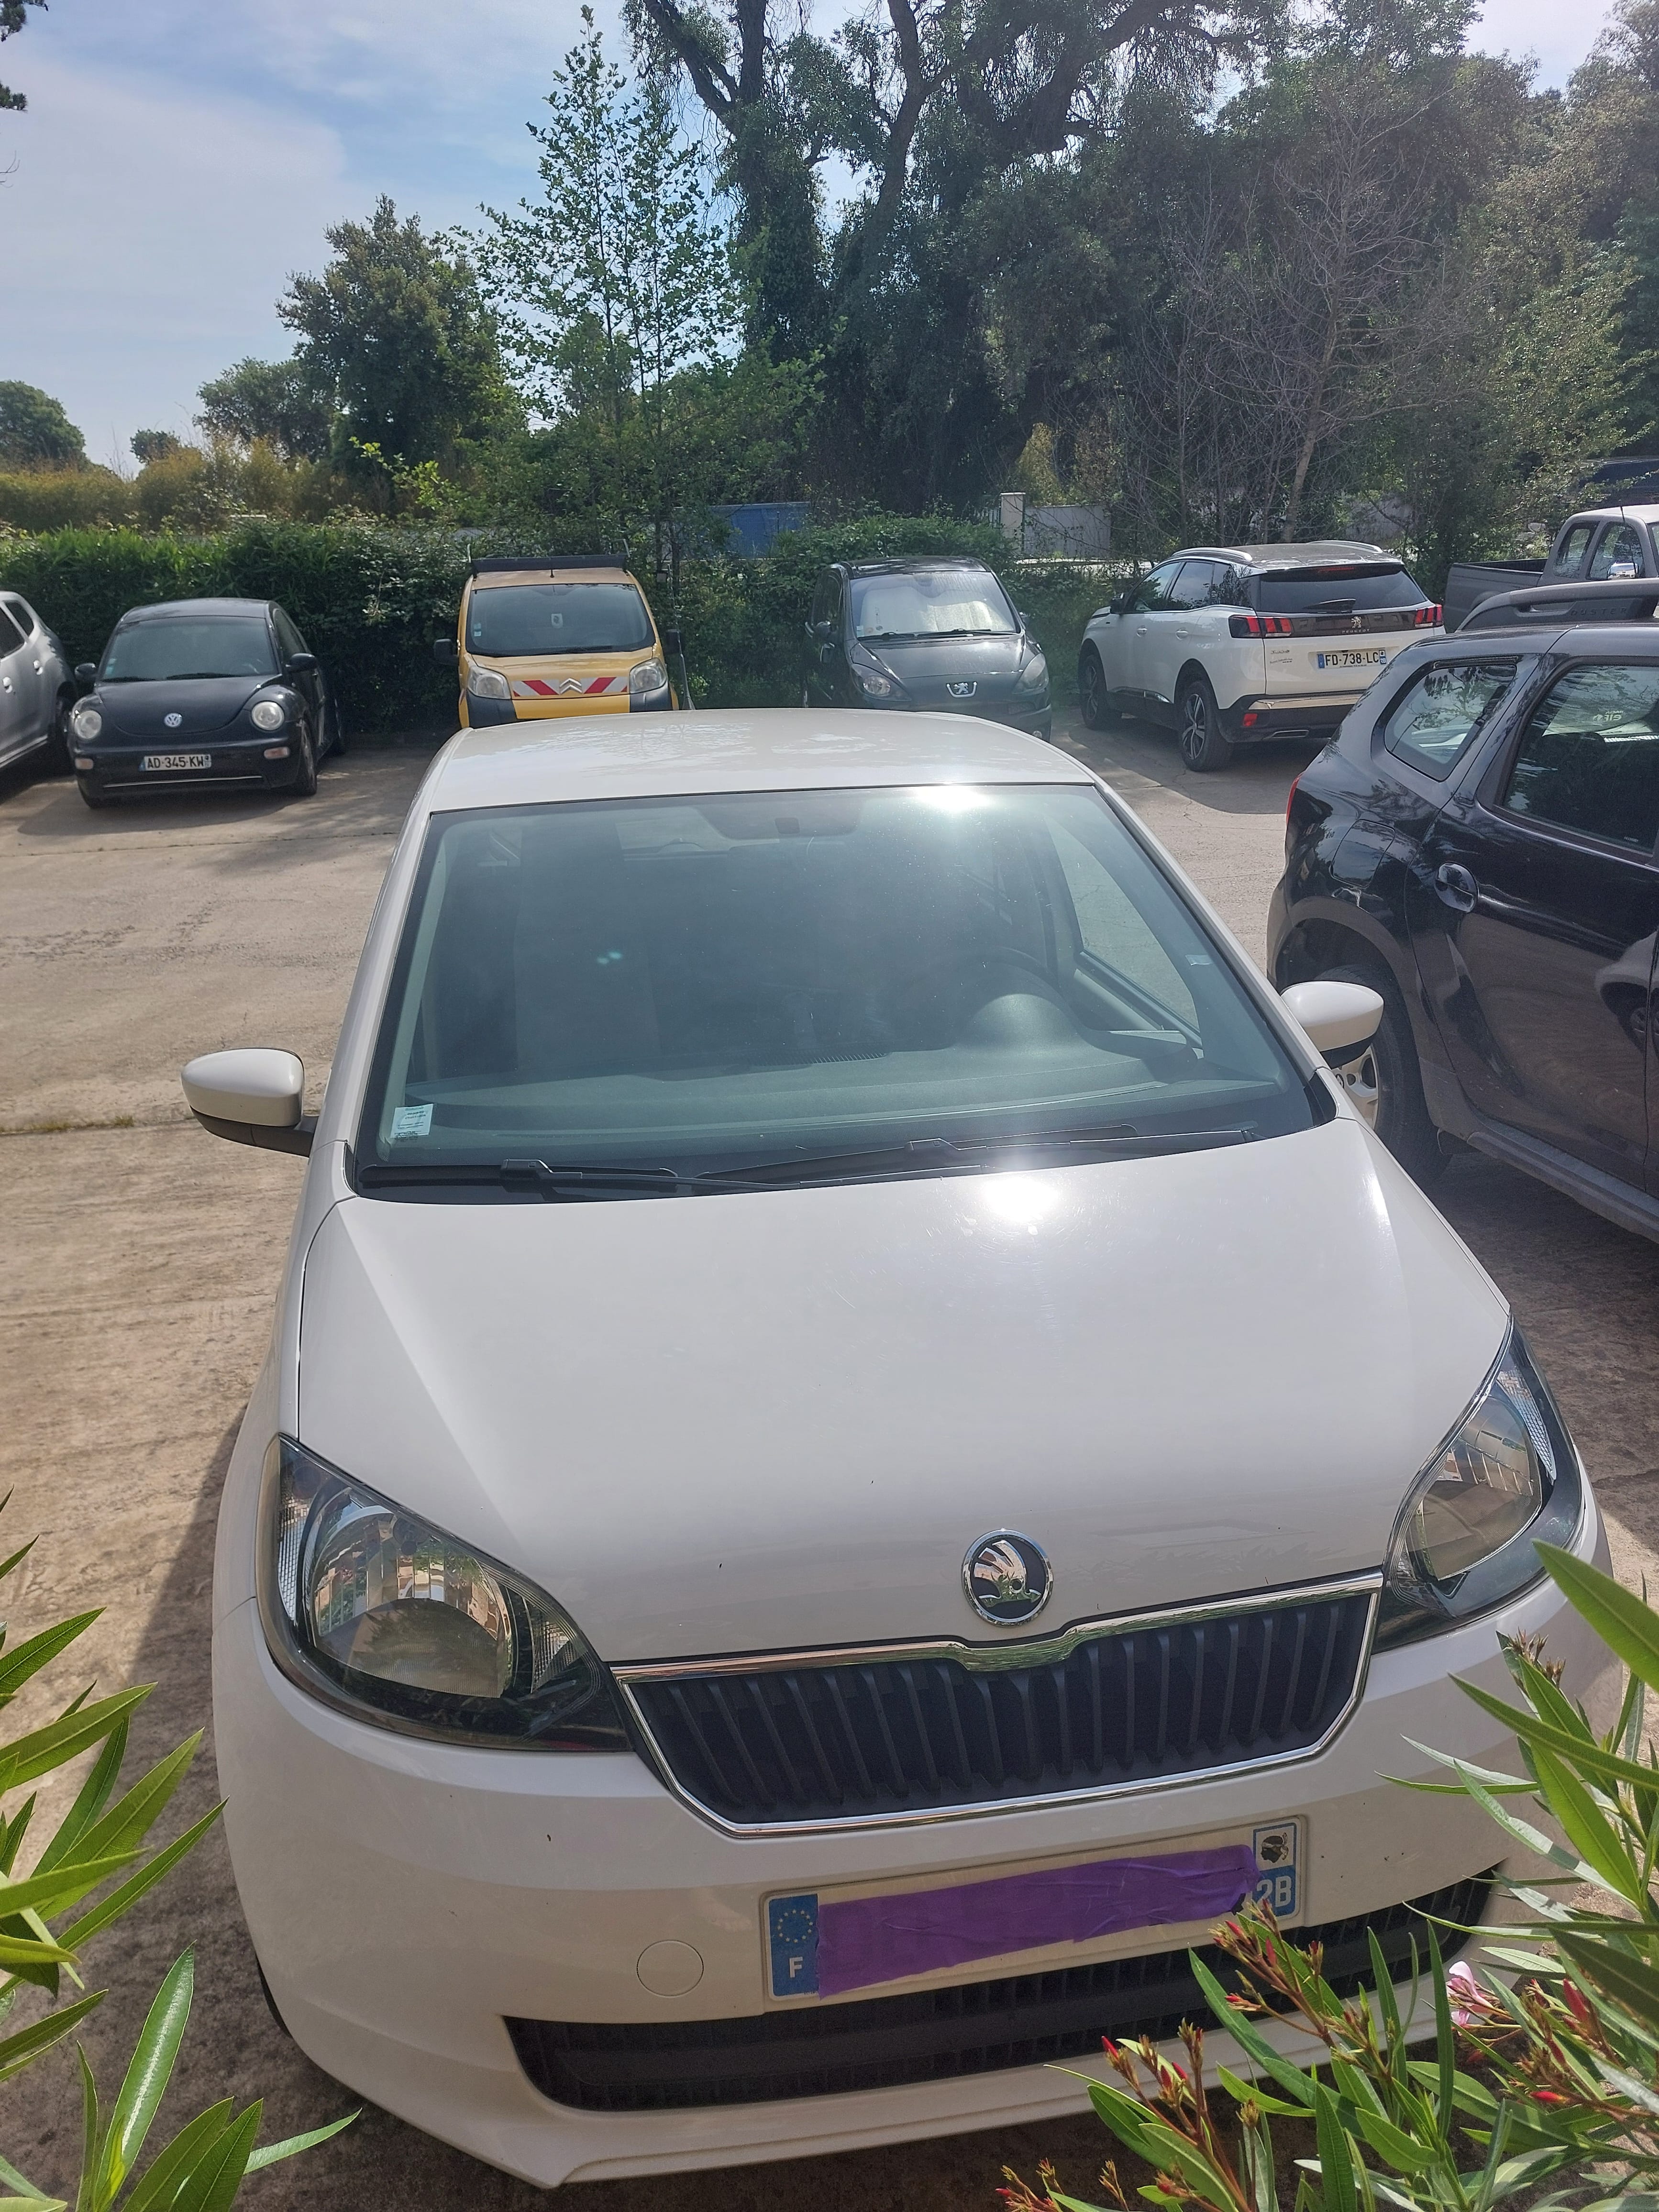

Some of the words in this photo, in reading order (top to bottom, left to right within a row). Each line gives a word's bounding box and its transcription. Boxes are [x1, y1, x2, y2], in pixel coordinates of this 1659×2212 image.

[1571, 607, 1626, 616] DUSTER
[1325, 652, 1379, 666] FD-738-LC
[147, 756, 204, 768] AD-345-KW
[1256, 1875, 1292, 1910] 2B
[789, 1957, 803, 1978] F
